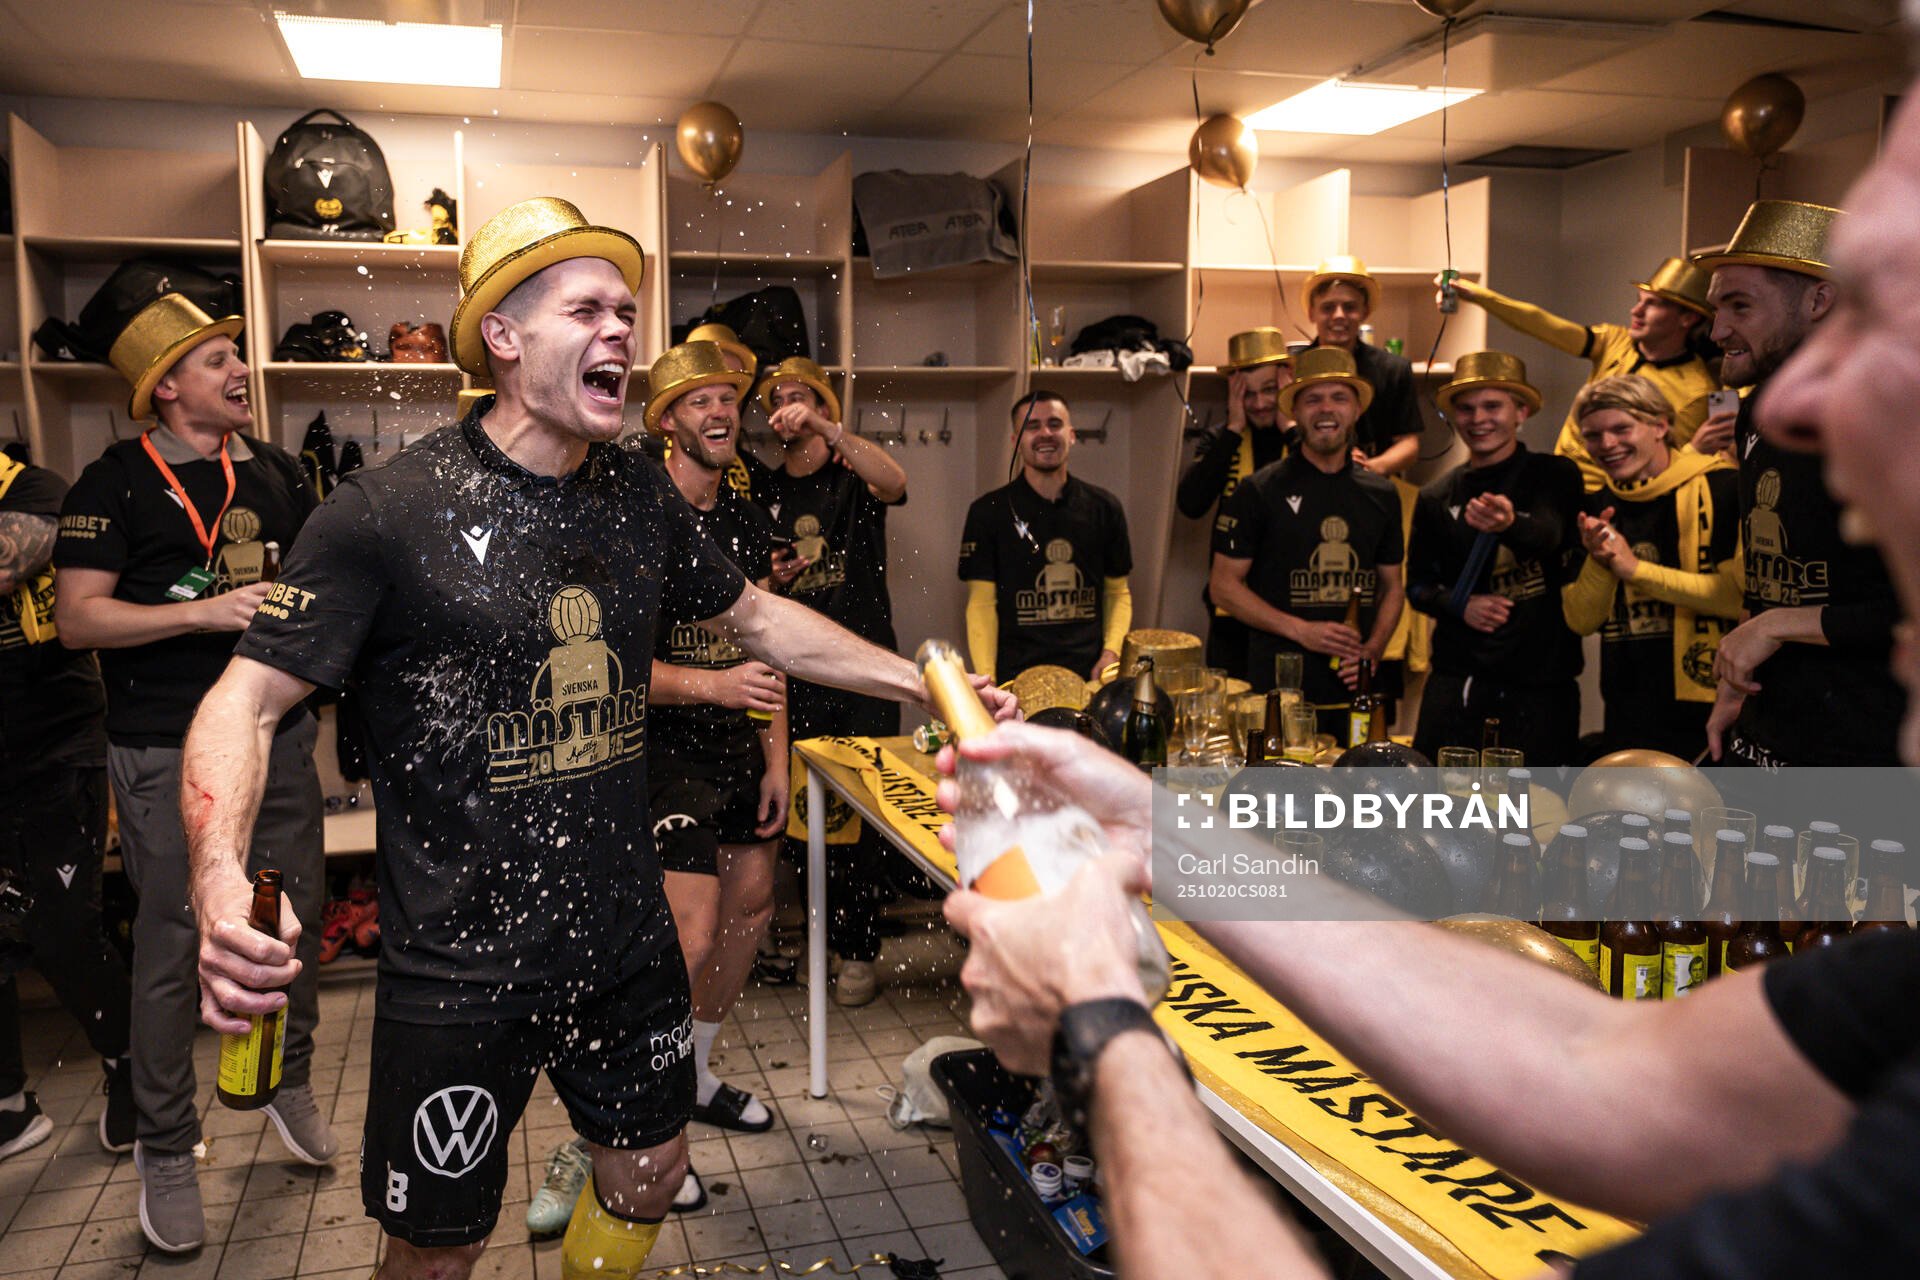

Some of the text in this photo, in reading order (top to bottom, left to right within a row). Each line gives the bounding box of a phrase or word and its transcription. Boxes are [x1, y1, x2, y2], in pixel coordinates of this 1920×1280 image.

[562, 679, 599, 697] SVENSKA
[487, 684, 646, 752] MÄSTARE
[528, 751, 553, 778] 20
[651, 1050, 676, 1071] on
[1234, 1045, 1588, 1234] MÄSTARE
[386, 1168, 409, 1213] 8
